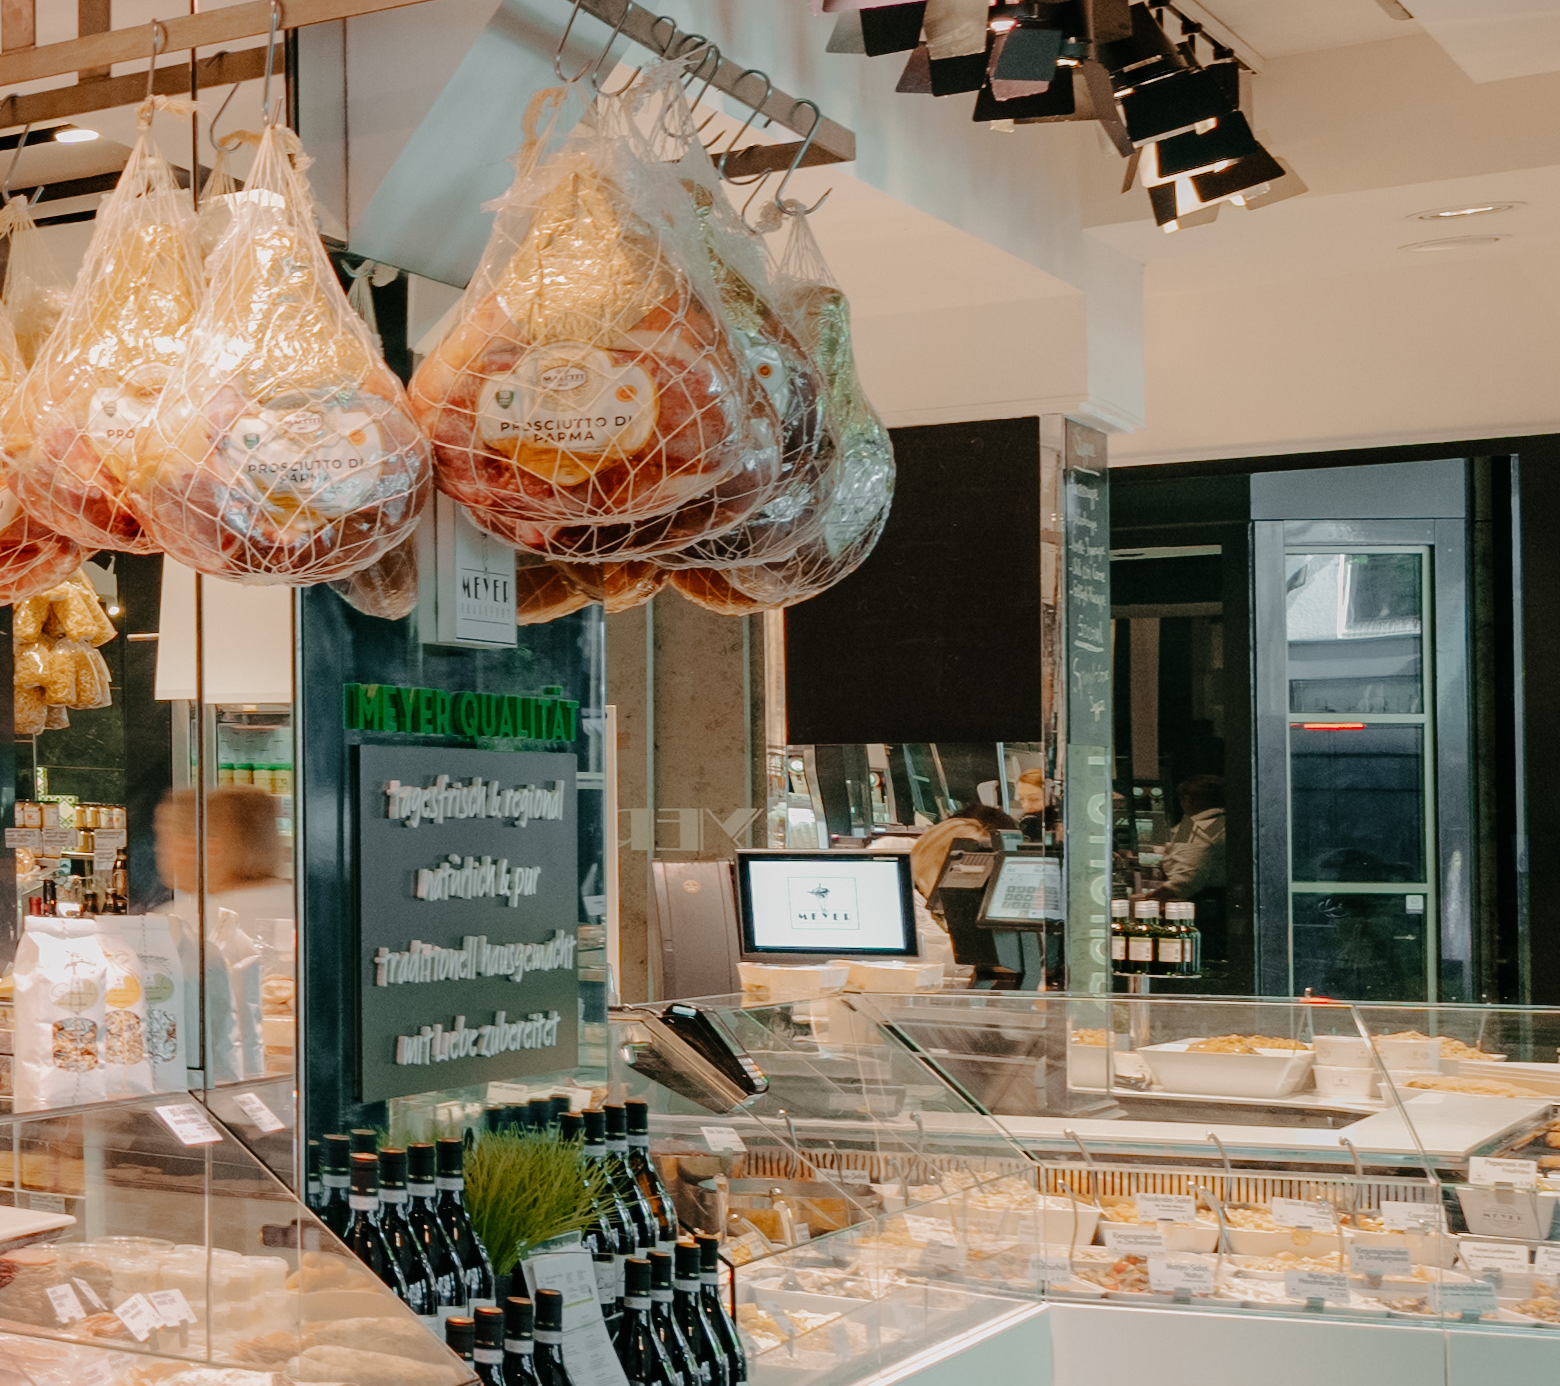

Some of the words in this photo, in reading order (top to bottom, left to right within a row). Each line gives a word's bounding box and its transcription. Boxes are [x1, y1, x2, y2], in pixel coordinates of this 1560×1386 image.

[500, 417, 607, 432] PROSCIUTTO
[615, 415, 632, 426] DI
[534, 431, 595, 444] PARMA
[248, 459, 342, 474] PROSCIUTTO
[349, 458, 365, 469] DI
[462, 576, 511, 604] MEYER
[345, 683, 452, 735] MEYER
[454, 684, 580, 743] QUALITÄT
[387, 774, 487, 828] tagesfrisch
[501, 779, 565, 828] regional
[417, 854, 496, 901] natürlich
[508, 866, 542, 907] pur
[797, 912, 852, 921] MEYER
[374, 935, 477, 987] traditionell
[477, 929, 577, 983] hausgemacht
[396, 1026, 432, 1065] mit
[431, 1015, 478, 1062] Liebe
[477, 1011, 561, 1058] zubereitet
